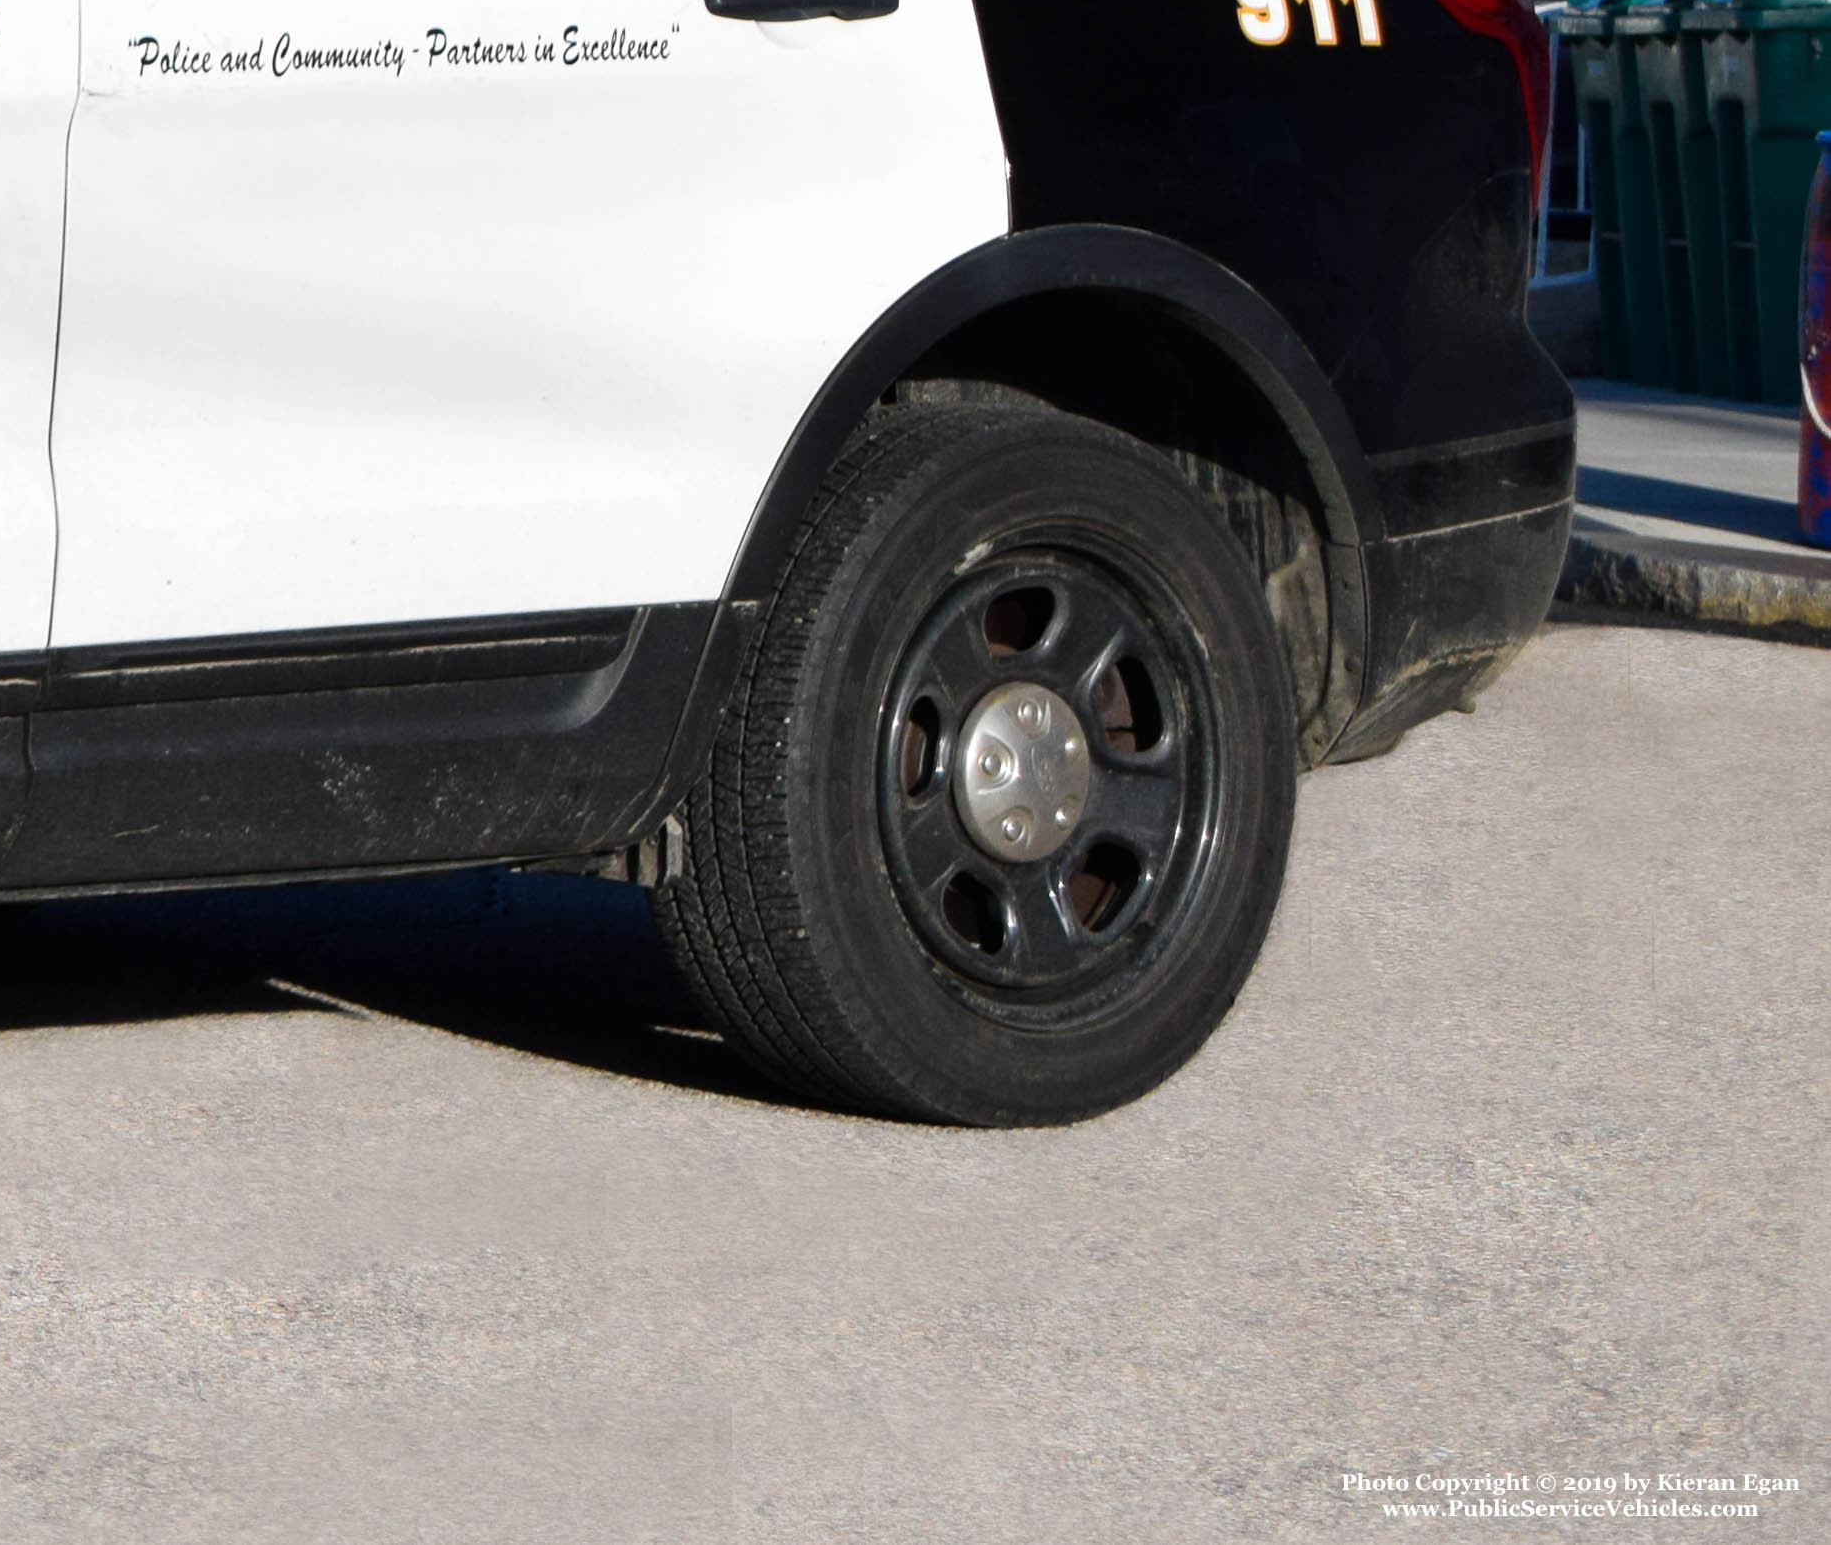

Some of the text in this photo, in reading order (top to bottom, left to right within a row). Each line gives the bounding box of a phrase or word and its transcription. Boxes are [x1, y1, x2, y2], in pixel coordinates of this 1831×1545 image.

[220, 39, 264, 73] and
[272, 32, 404, 78] Community
[426, 28, 527, 67] Partners
[534, 35, 556, 62] in
